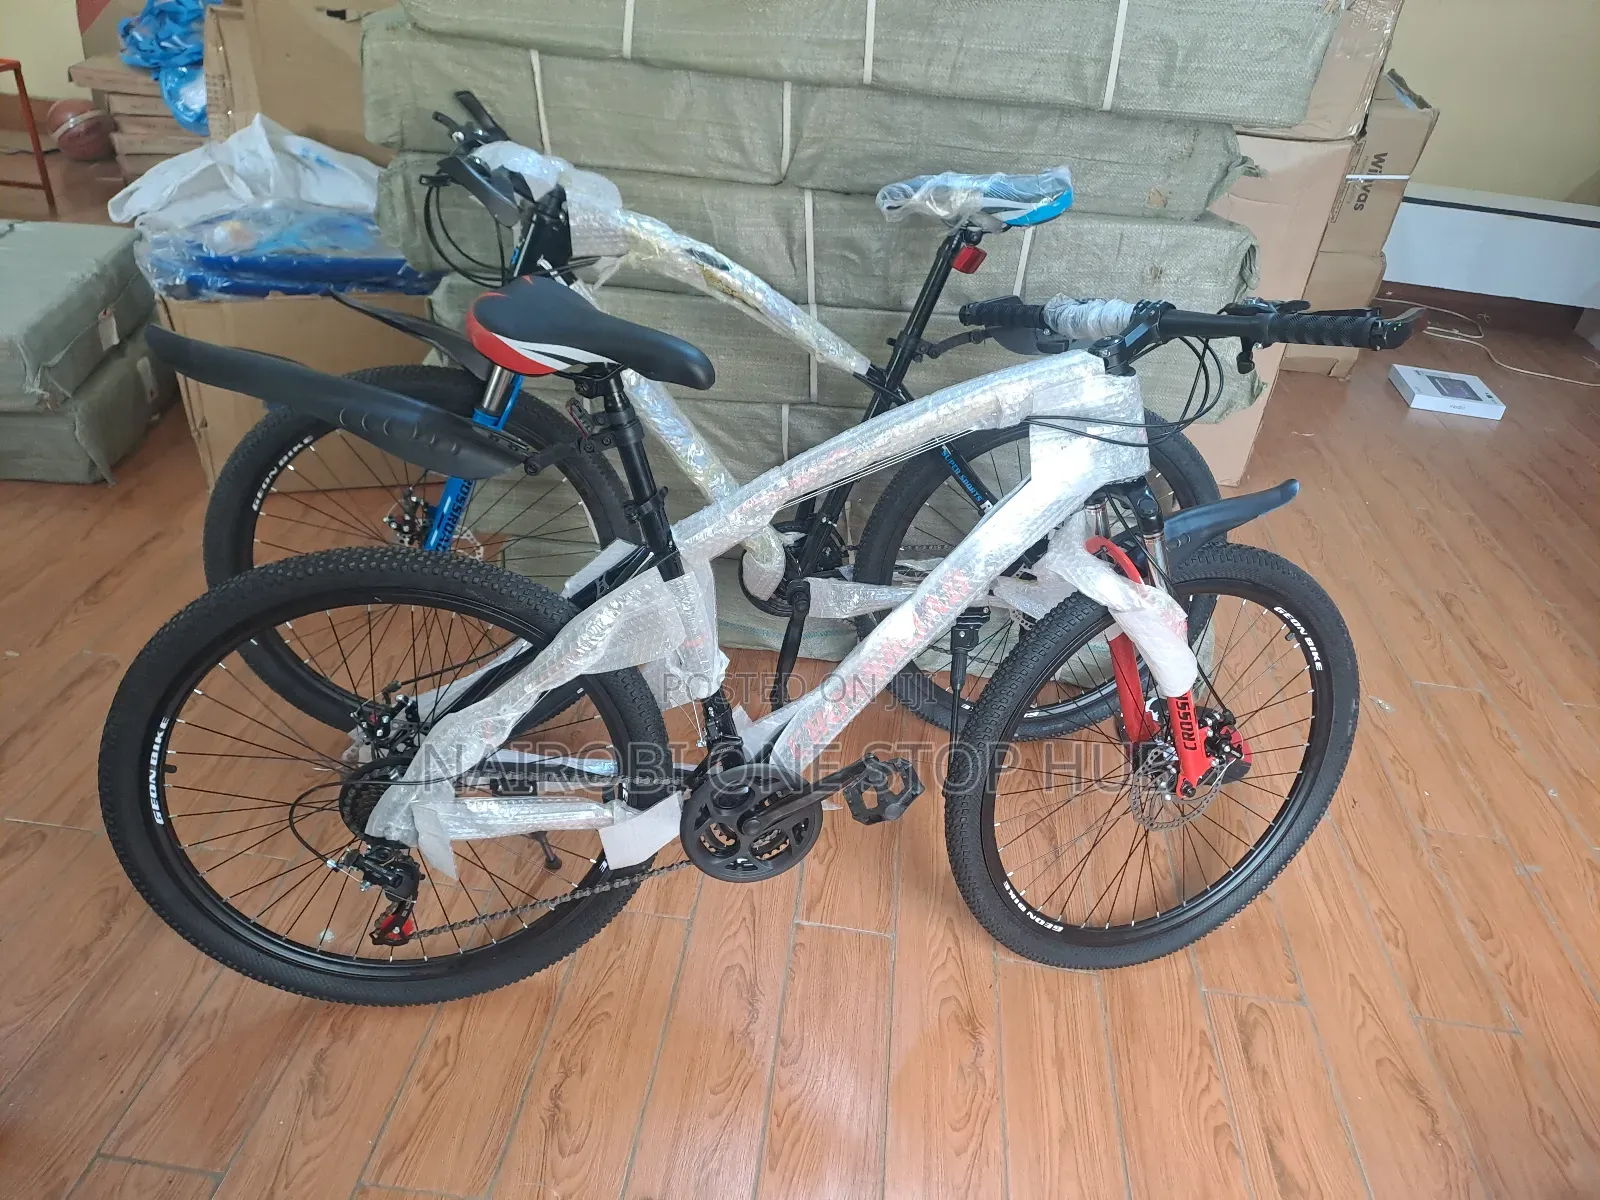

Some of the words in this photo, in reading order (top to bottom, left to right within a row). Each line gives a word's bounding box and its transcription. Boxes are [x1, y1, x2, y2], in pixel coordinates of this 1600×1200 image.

[278, 435, 314, 467] BIKE
[941, 449, 962, 475] SUPER
[1273, 606, 1308, 635] GEON
[1304, 637, 1323, 671] BIKE
[149, 716, 170, 767] BIKE
[148, 769, 165, 825] GEON
[1003, 880, 1027, 912] BIKE
[1026, 910, 1064, 933] GEON
